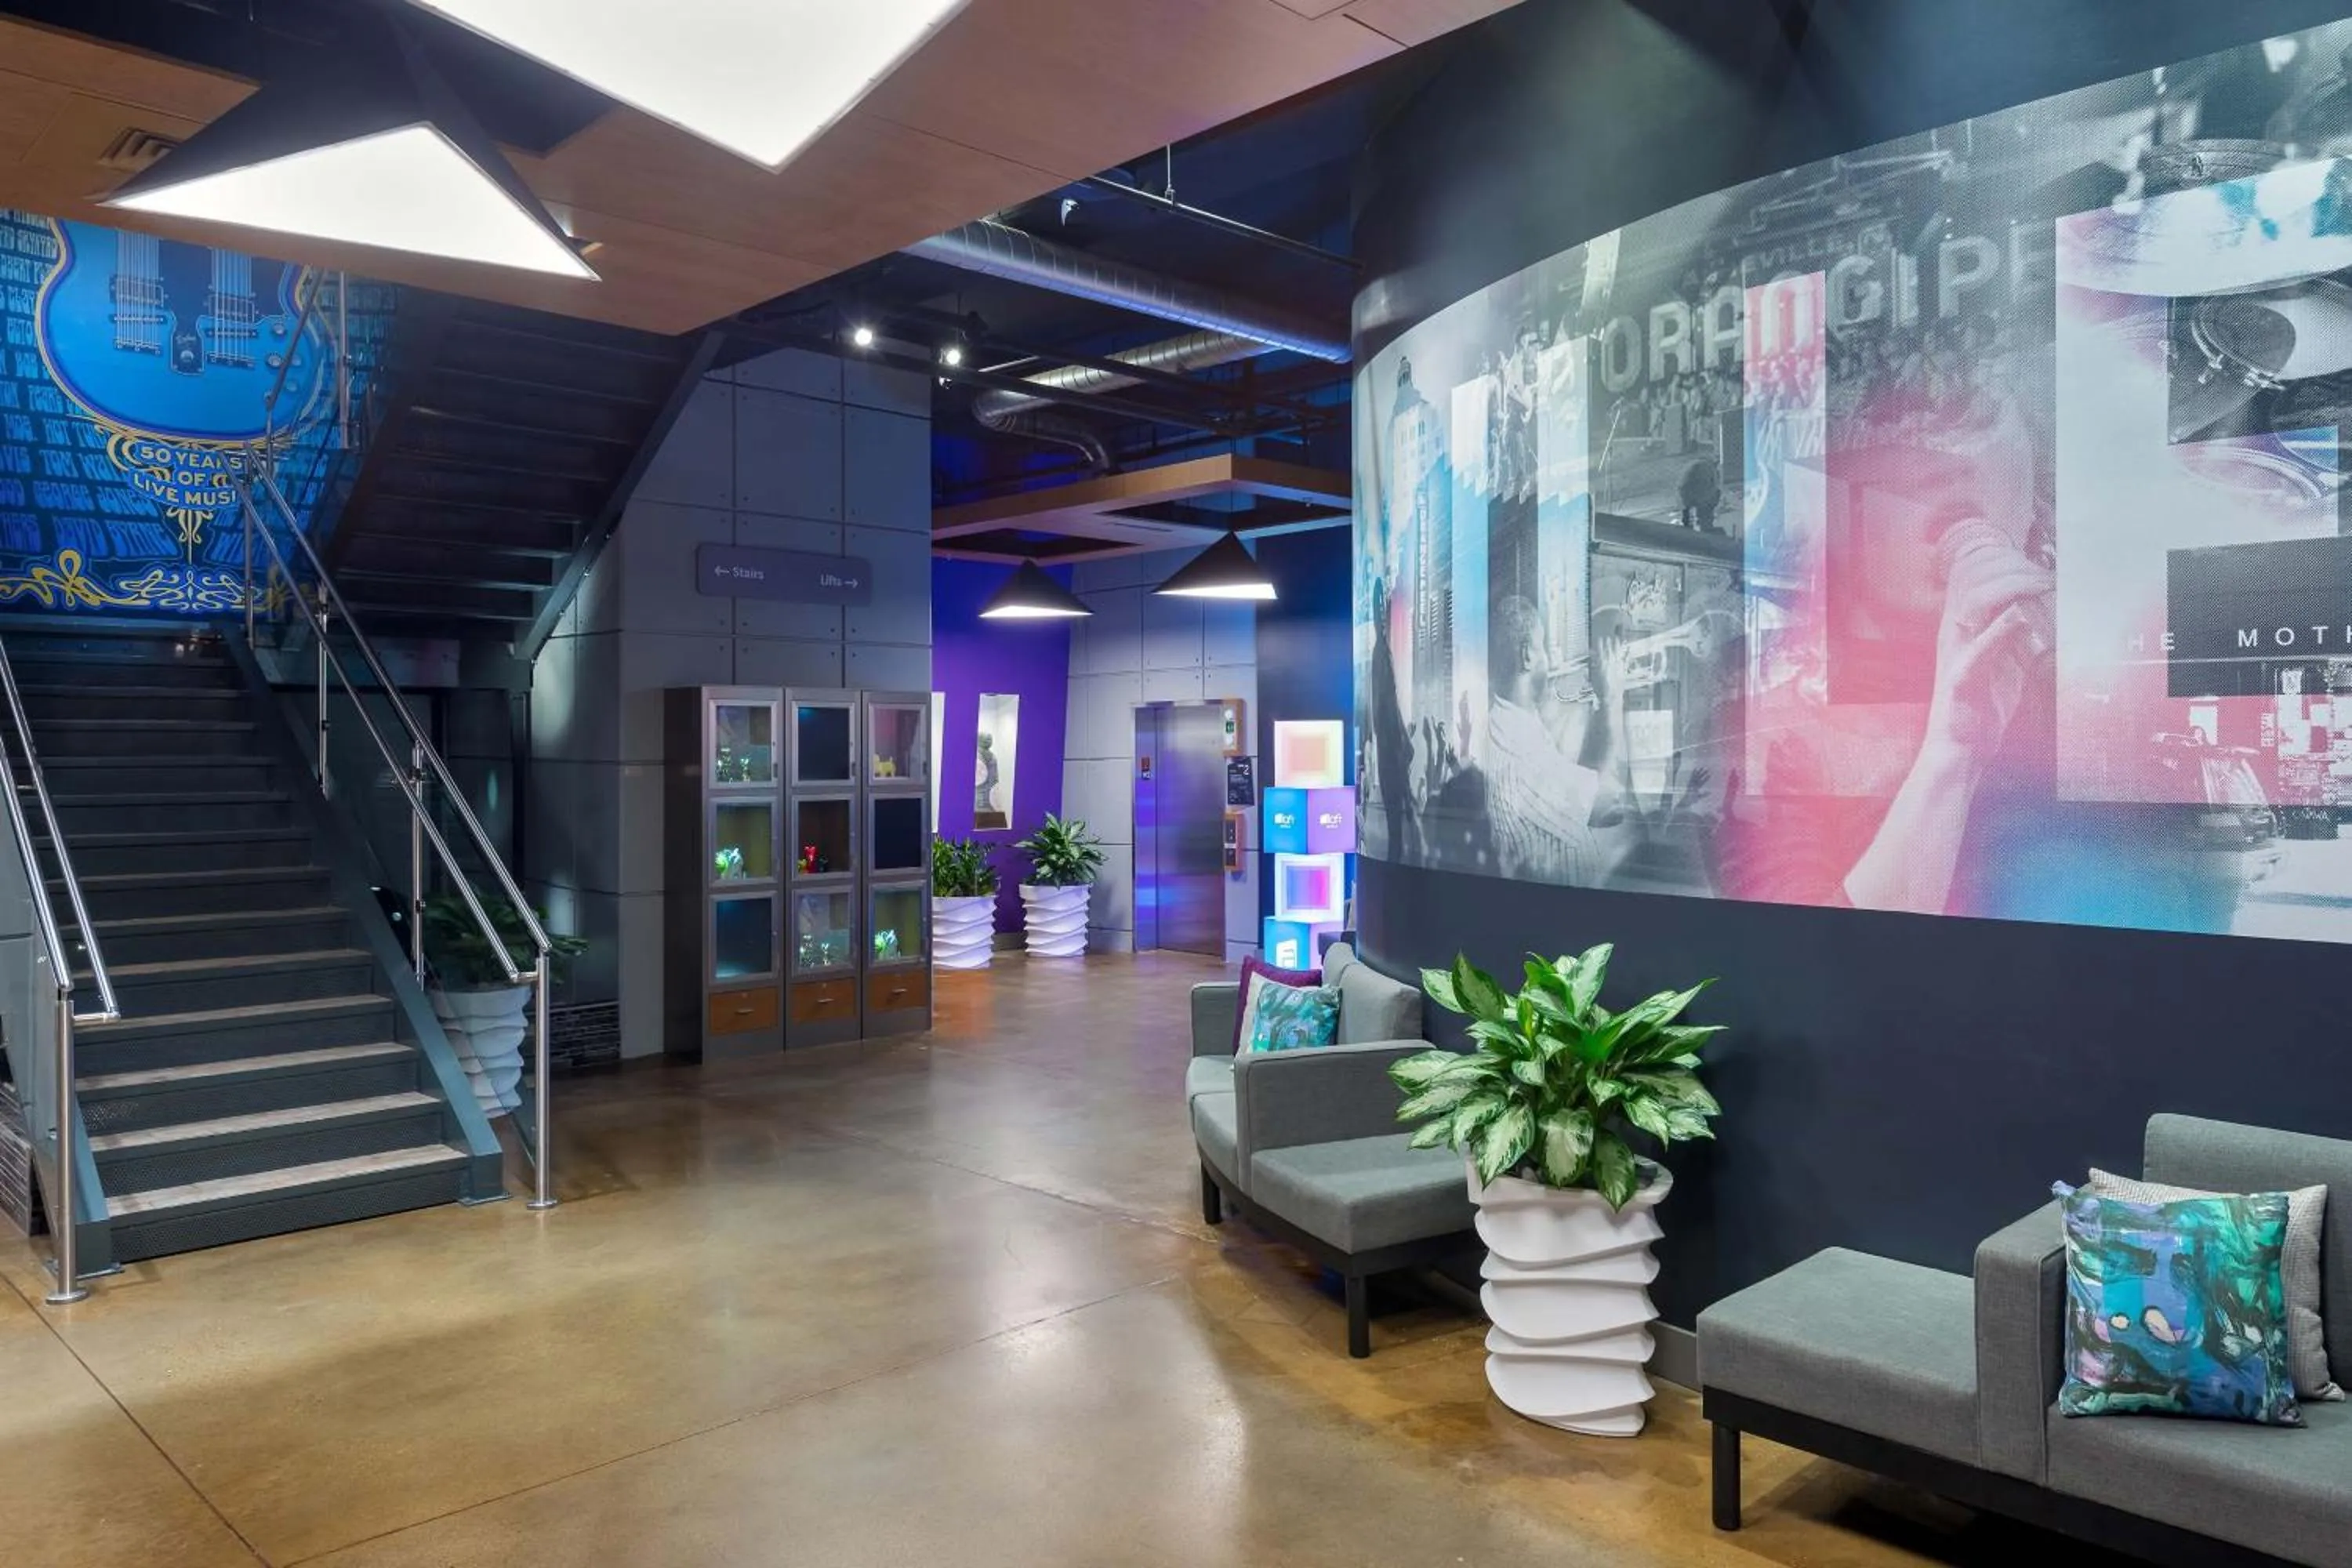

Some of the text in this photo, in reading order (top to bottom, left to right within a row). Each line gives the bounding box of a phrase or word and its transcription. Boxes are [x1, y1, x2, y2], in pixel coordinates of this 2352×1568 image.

[140, 446, 172, 463] 50
[78, 452, 128, 483] WAI
[178, 471, 206, 486] OF
[133, 473, 237, 506] LIVE MUSI
[732, 564, 765, 580] Stairs
[820, 573, 843, 587] Lifts
